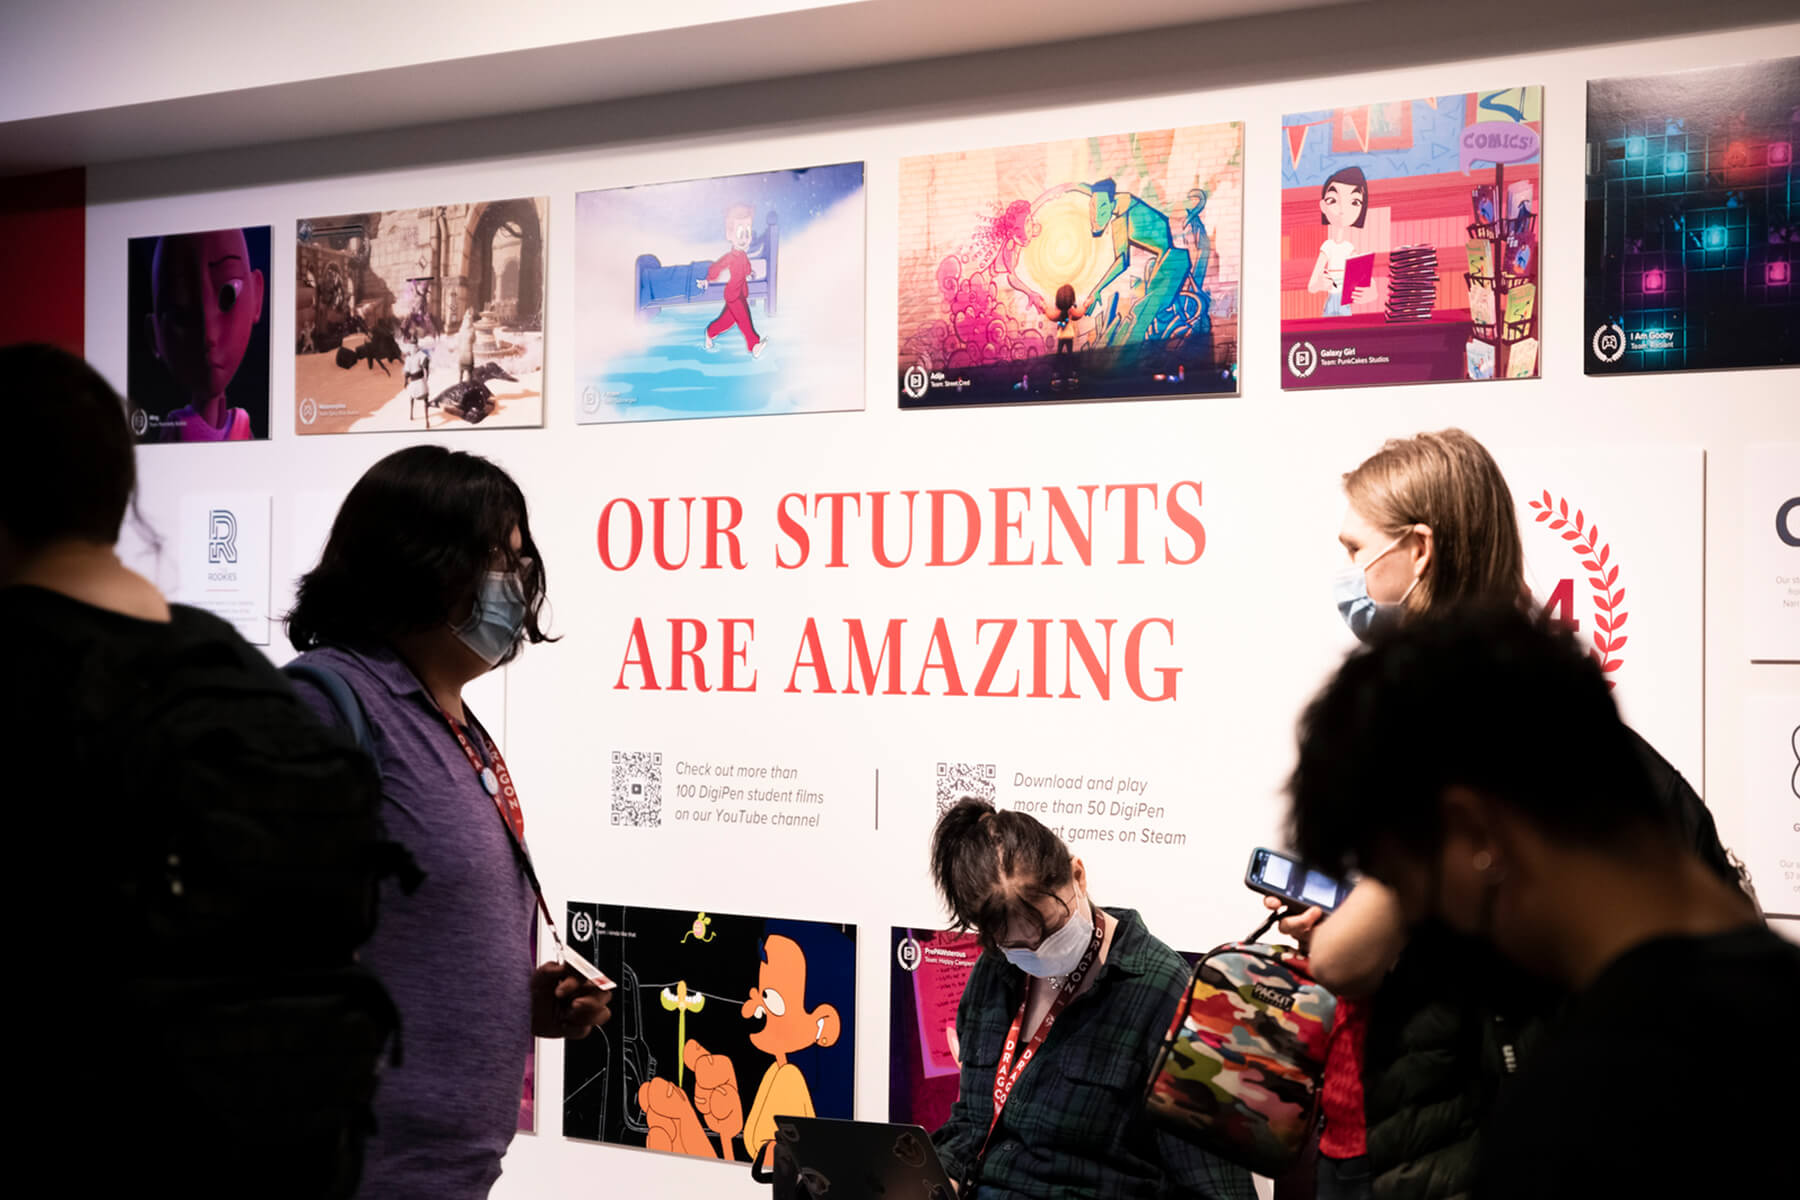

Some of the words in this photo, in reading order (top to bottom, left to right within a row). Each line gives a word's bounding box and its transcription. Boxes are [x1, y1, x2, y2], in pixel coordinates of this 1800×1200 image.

[1463, 132, 1533, 150] COMICS!
[1635, 332, 1648, 340] Am
[1320, 349, 1343, 358] Galaxy
[1344, 347, 1356, 356] Girl
[597, 496, 748, 571] OUR
[775, 481, 1207, 569] STUDENTS
[613, 617, 758, 692] ARE
[784, 617, 1184, 702] AMAZING
[675, 761, 712, 777] Check
[714, 764, 735, 777] out
[736, 766, 768, 779] more
[770, 764, 799, 780] than
[675, 784, 696, 799] 100
[698, 784, 745, 804] DigiPen
[747, 788, 793, 804] student
[795, 788, 825, 805] films
[1013, 772, 1084, 790] Download
[1086, 775, 1114, 792] and
[1116, 777, 1149, 797] play
[674, 808, 690, 821] on
[692, 810, 713, 822] our
[715, 808, 769, 825] YouTube
[770, 811, 821, 828] channel
[1013, 800, 1049, 814] more
[1051, 799, 1084, 815] than
[1087, 800, 1107, 817] 50
[1109, 801, 1166, 822] DigiPen
[1067, 828, 1114, 845] games
[1117, 830, 1137, 843] on
[1140, 828, 1187, 846] Steam
[1063, 927, 1104, 994] DRAGON
[1000, 1049, 1033, 1105] DRAGO
